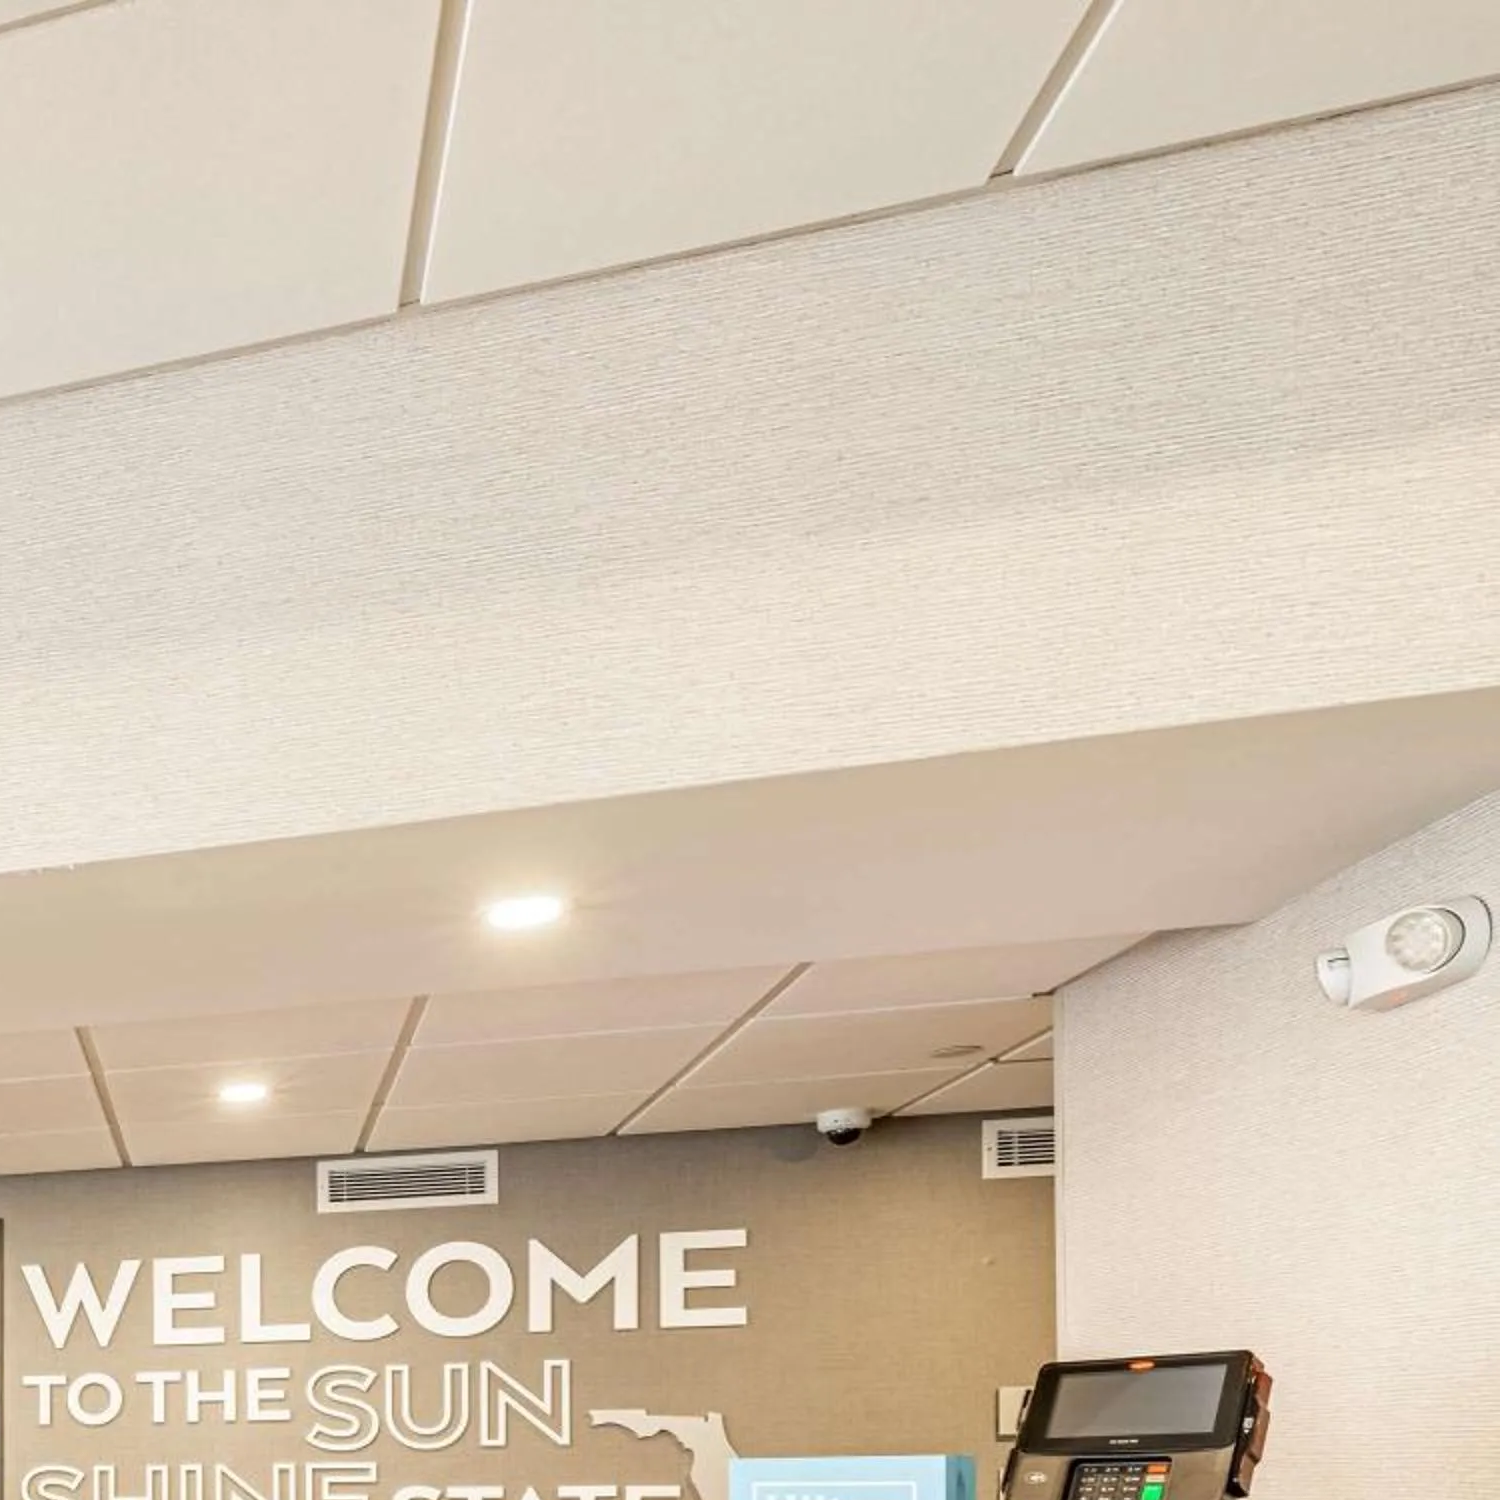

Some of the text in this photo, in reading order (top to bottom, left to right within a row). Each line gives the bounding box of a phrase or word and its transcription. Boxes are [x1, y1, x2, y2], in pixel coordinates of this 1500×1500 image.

[21, 1229, 747, 1349] WELCOME
[21, 1359, 571, 1451] TO THE SUN
